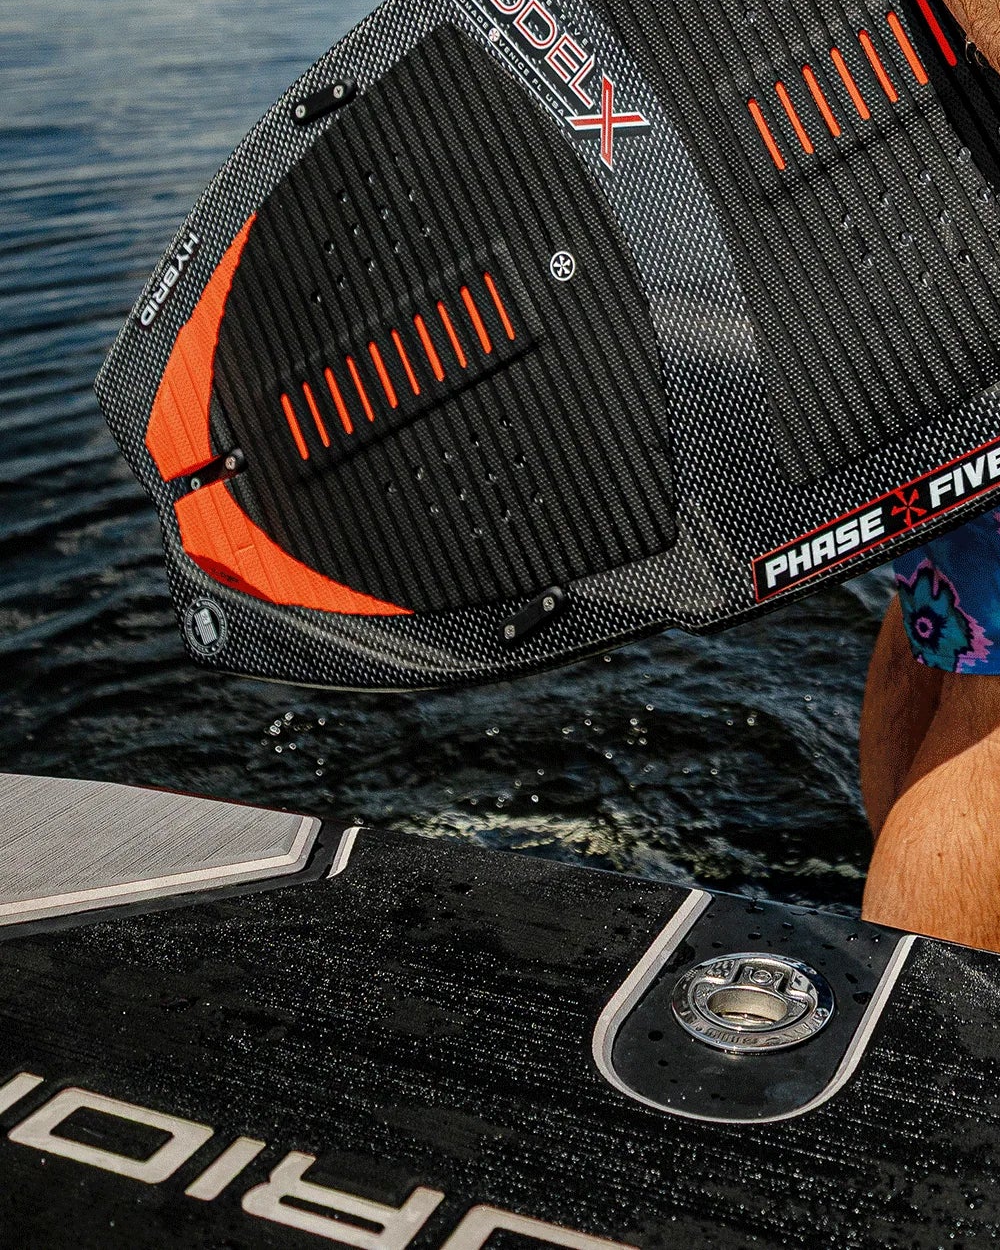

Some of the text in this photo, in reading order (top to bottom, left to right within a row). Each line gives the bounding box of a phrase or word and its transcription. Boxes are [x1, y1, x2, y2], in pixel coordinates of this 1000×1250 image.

[499, 39, 531, 77] VENICE
[532, 78, 543, 92] FL
[545, 94, 566, 117] USA
[140, 231, 200, 326] HYBRID
[764, 507, 886, 589] PHASE
